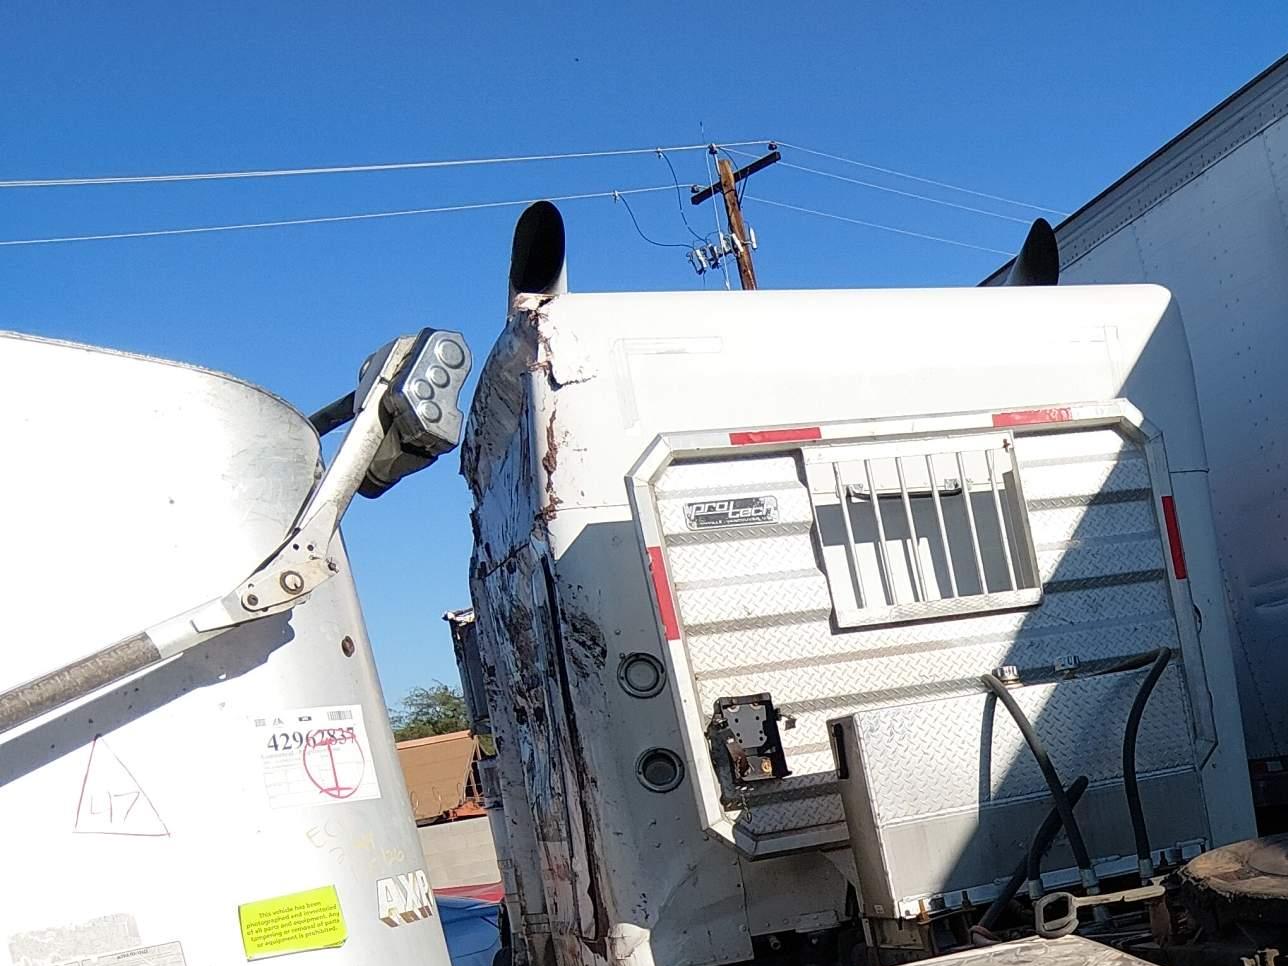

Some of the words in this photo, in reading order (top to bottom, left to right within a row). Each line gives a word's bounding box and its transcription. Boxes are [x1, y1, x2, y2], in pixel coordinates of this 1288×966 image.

[246, 915, 290, 929] photographed
[290, 910, 303, 918] and
[303, 904, 337, 915] inventoried
[272, 907, 293, 916] vehicle
[294, 904, 307, 912] has
[306, 901, 321, 909] been
[250, 931, 283, 942] tampering
[291, 923, 316, 933] removal
[324, 918, 340, 926] parts
[264, 925, 280, 933] parts
[328, 912, 340, 920] Any
[264, 935, 298, 947] equipment
